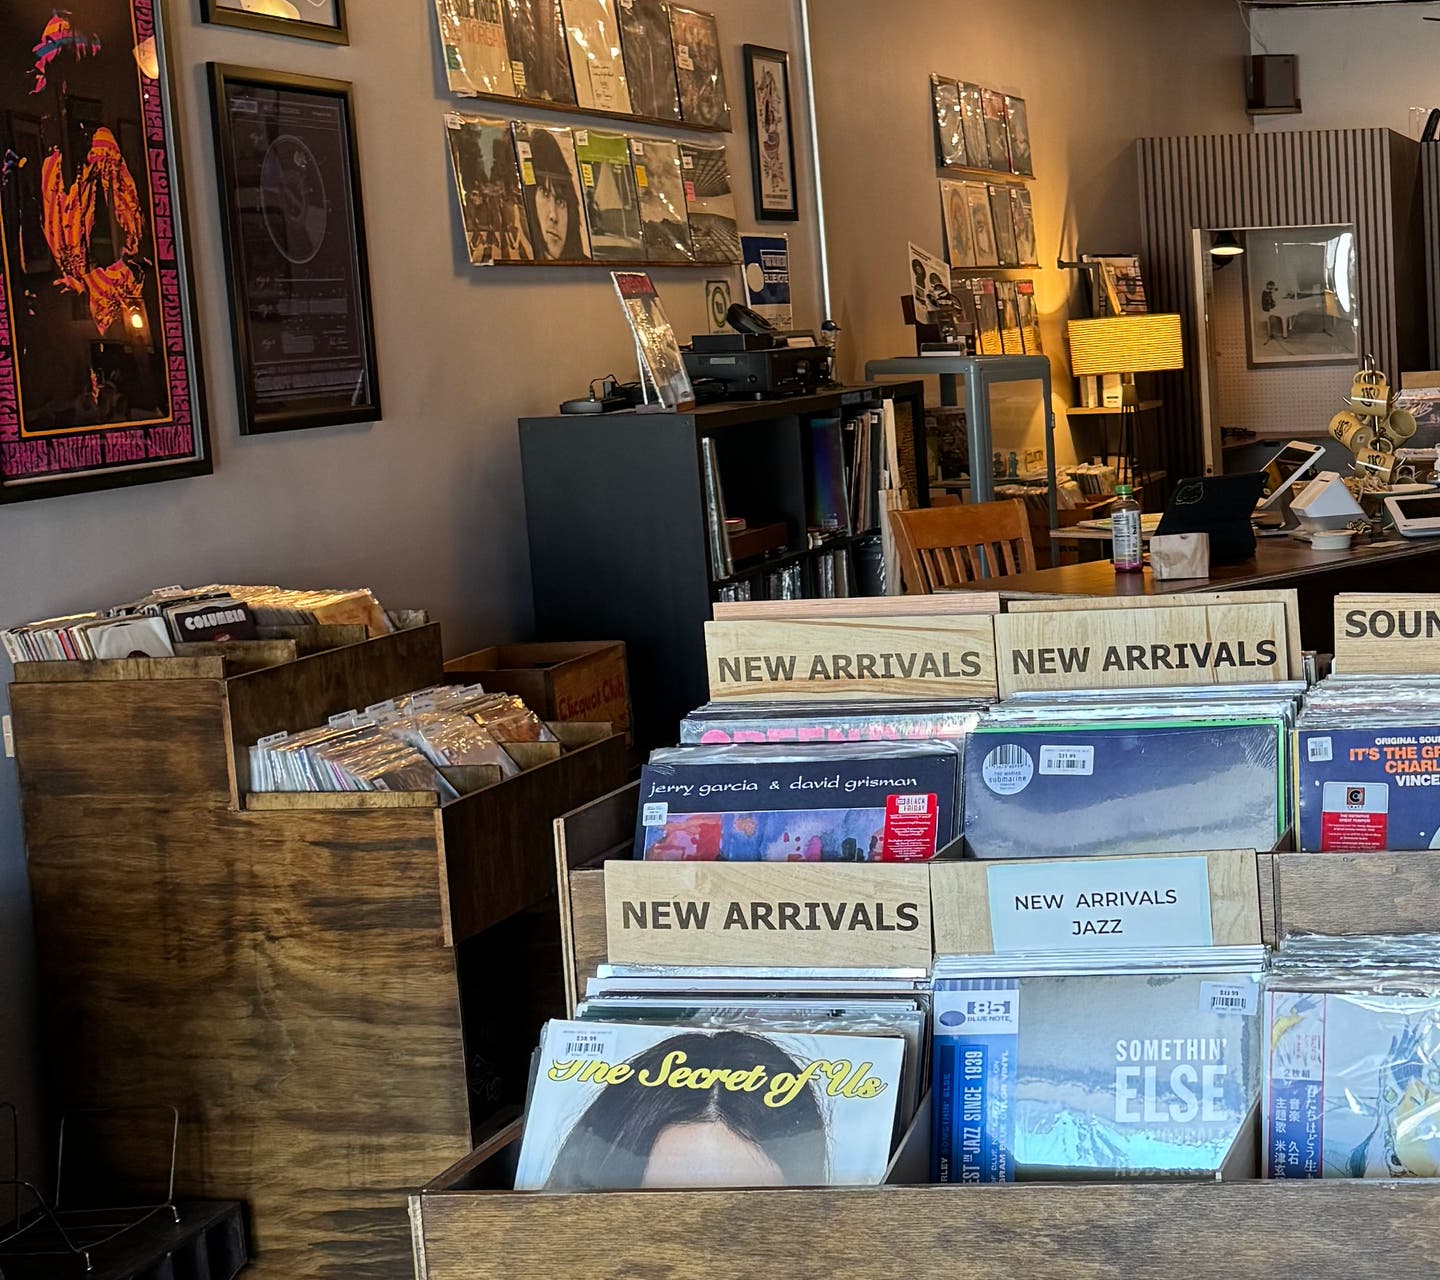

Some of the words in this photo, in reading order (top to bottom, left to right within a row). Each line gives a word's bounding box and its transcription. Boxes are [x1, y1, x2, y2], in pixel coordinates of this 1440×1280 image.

[184, 609, 247, 631] COLUMBIA
[718, 655, 797, 683] NEW
[808, 651, 982, 681] ARRIVALS
[1011, 646, 1091, 675] NEW
[1102, 639, 1278, 671] ARRIVALS
[1349, 748, 1380, 761] IT'S
[1383, 746, 1420, 761] THE
[1375, 735, 1418, 746] ORIGINAL
[648, 781, 695, 798] jerry
[698, 778, 759, 797] garcia
[769, 781, 780, 790] &
[789, 774, 840, 791] david
[845, 775, 918, 792] grisman
[1395, 773, 1440, 788] VINCE
[1015, 894, 1064, 910] NEW
[1076, 889, 1177, 909] ARRIVALS
[622, 901, 711, 929] NEW
[723, 902, 919, 931] ARRIVALS
[1072, 919, 1123, 935] JAZZ
[1115, 1038, 1228, 1062] SOMETHIN'
[640, 1051, 768, 1093] Secret
[763, 1060, 826, 1108] of
[816, 1059, 890, 1100] Us
[964, 1051, 984, 1081] 1939
[1001, 1049, 1009, 1081] VINYL
[963, 1085, 983, 1121] SINCE
[1115, 1064, 1229, 1123] ELSE
[963, 1126, 982, 1155] JAZZ
[1304, 1084, 1321, 1177] 君たちはどう生
